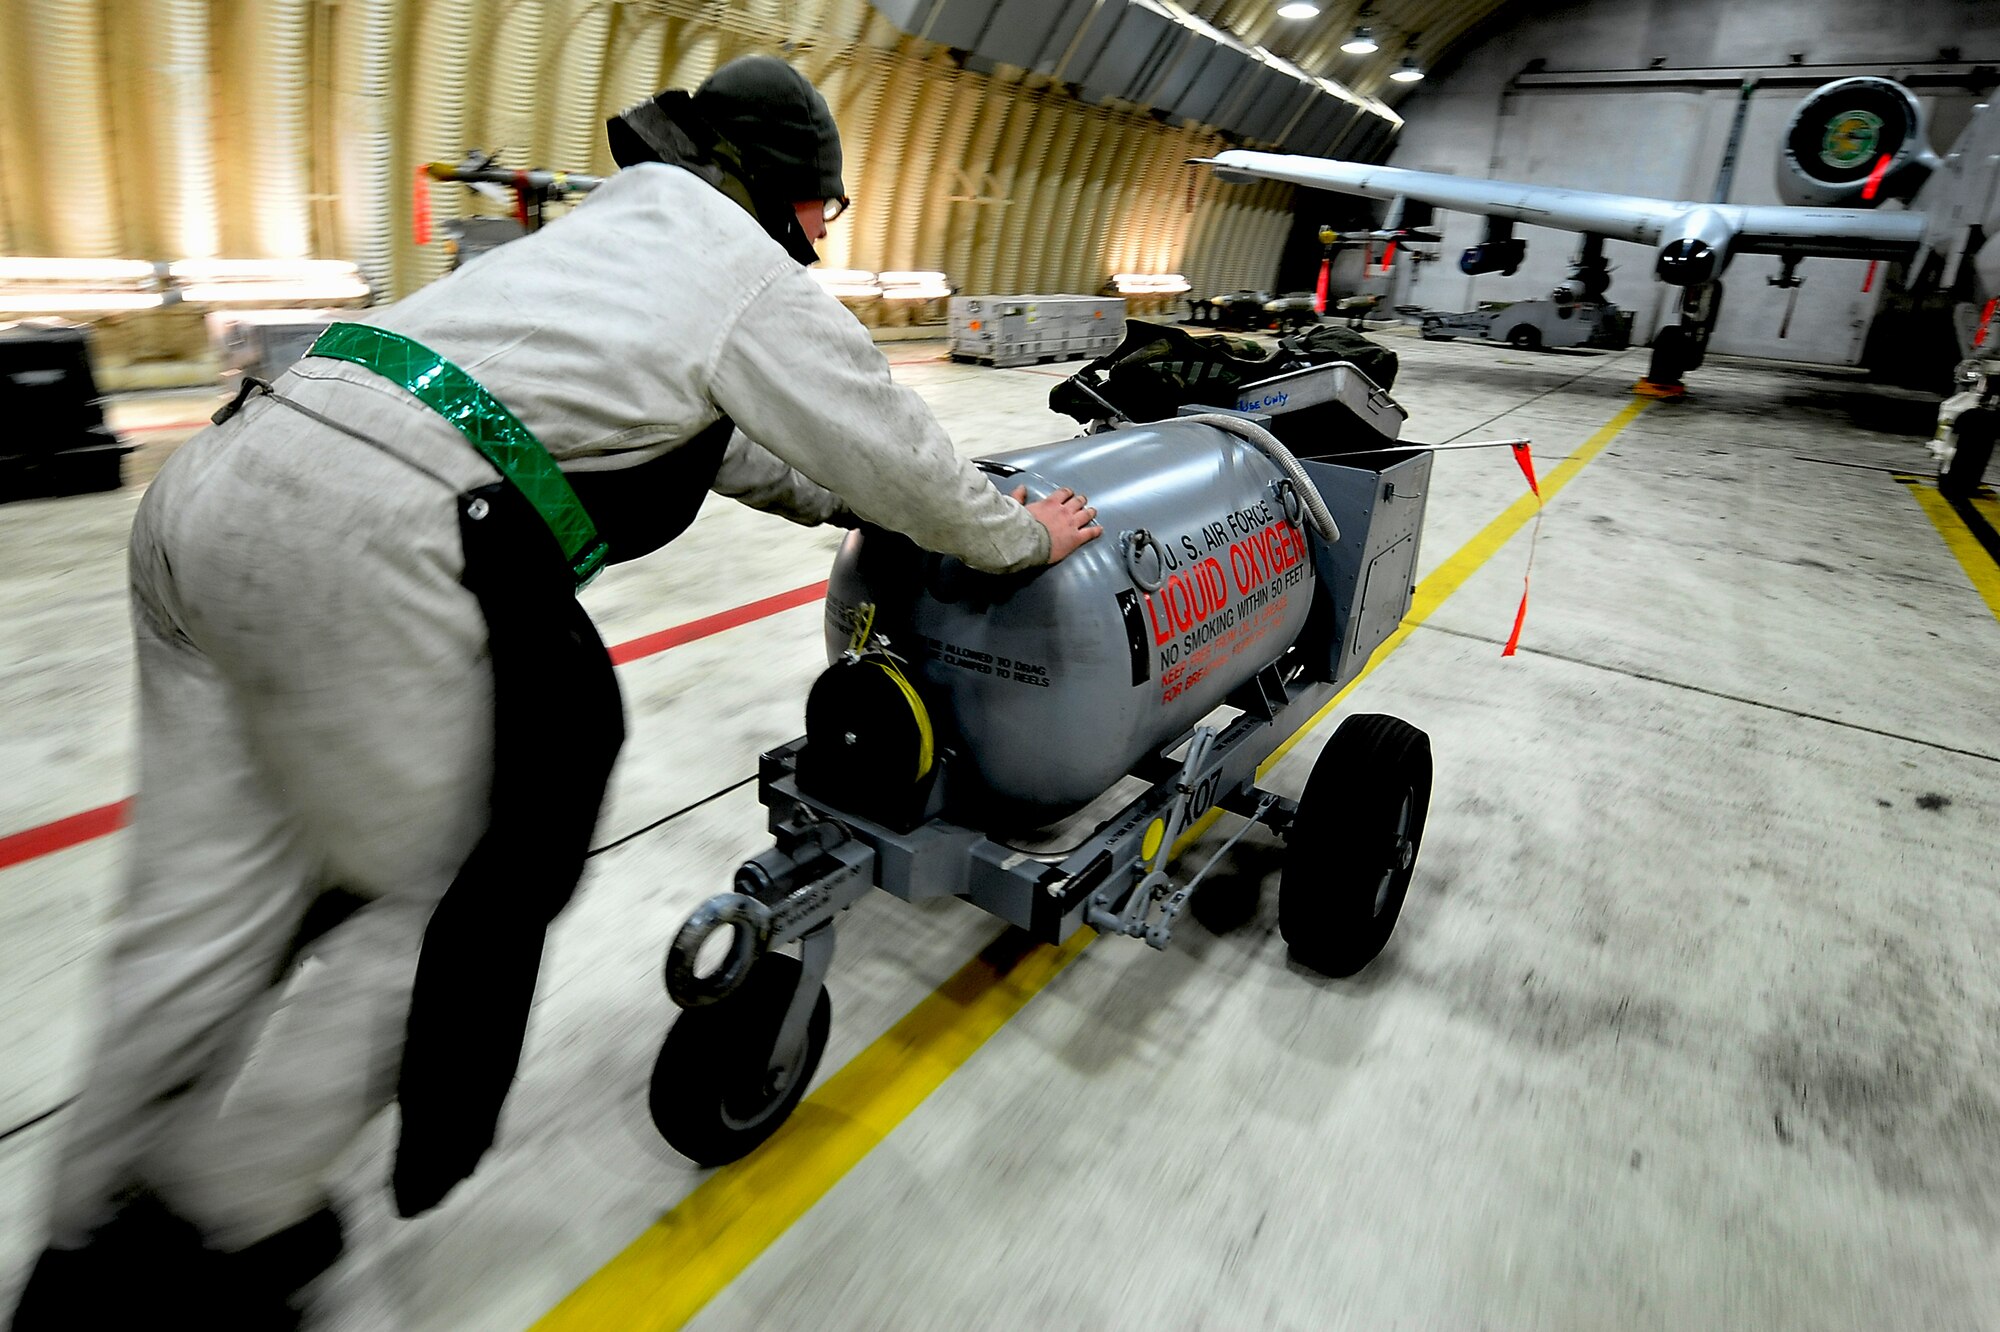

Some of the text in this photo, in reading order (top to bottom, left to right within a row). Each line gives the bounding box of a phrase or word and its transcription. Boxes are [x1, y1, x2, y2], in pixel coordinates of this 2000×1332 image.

[1180, 535, 1202, 561] S.
[1201, 522, 1230, 551] AIR
[1226, 499, 1274, 539] FORCE
[1143, 556, 1229, 648] LIQUID
[1228, 518, 1307, 597] OXYGEN
[1160, 642, 1180, 672] NO
[1183, 607, 1235, 656] SMOKING
[1236, 583, 1269, 621] WITHIN
[1270, 581, 1283, 599] 50
[1284, 564, 1305, 591] FEET
[945, 644, 994, 665] ALLOWED
[996, 656, 1011, 669] TO
[1013, 661, 1047, 677] DRAG
[996, 667, 1010, 679] TO
[1013, 672, 1050, 688] REELS
